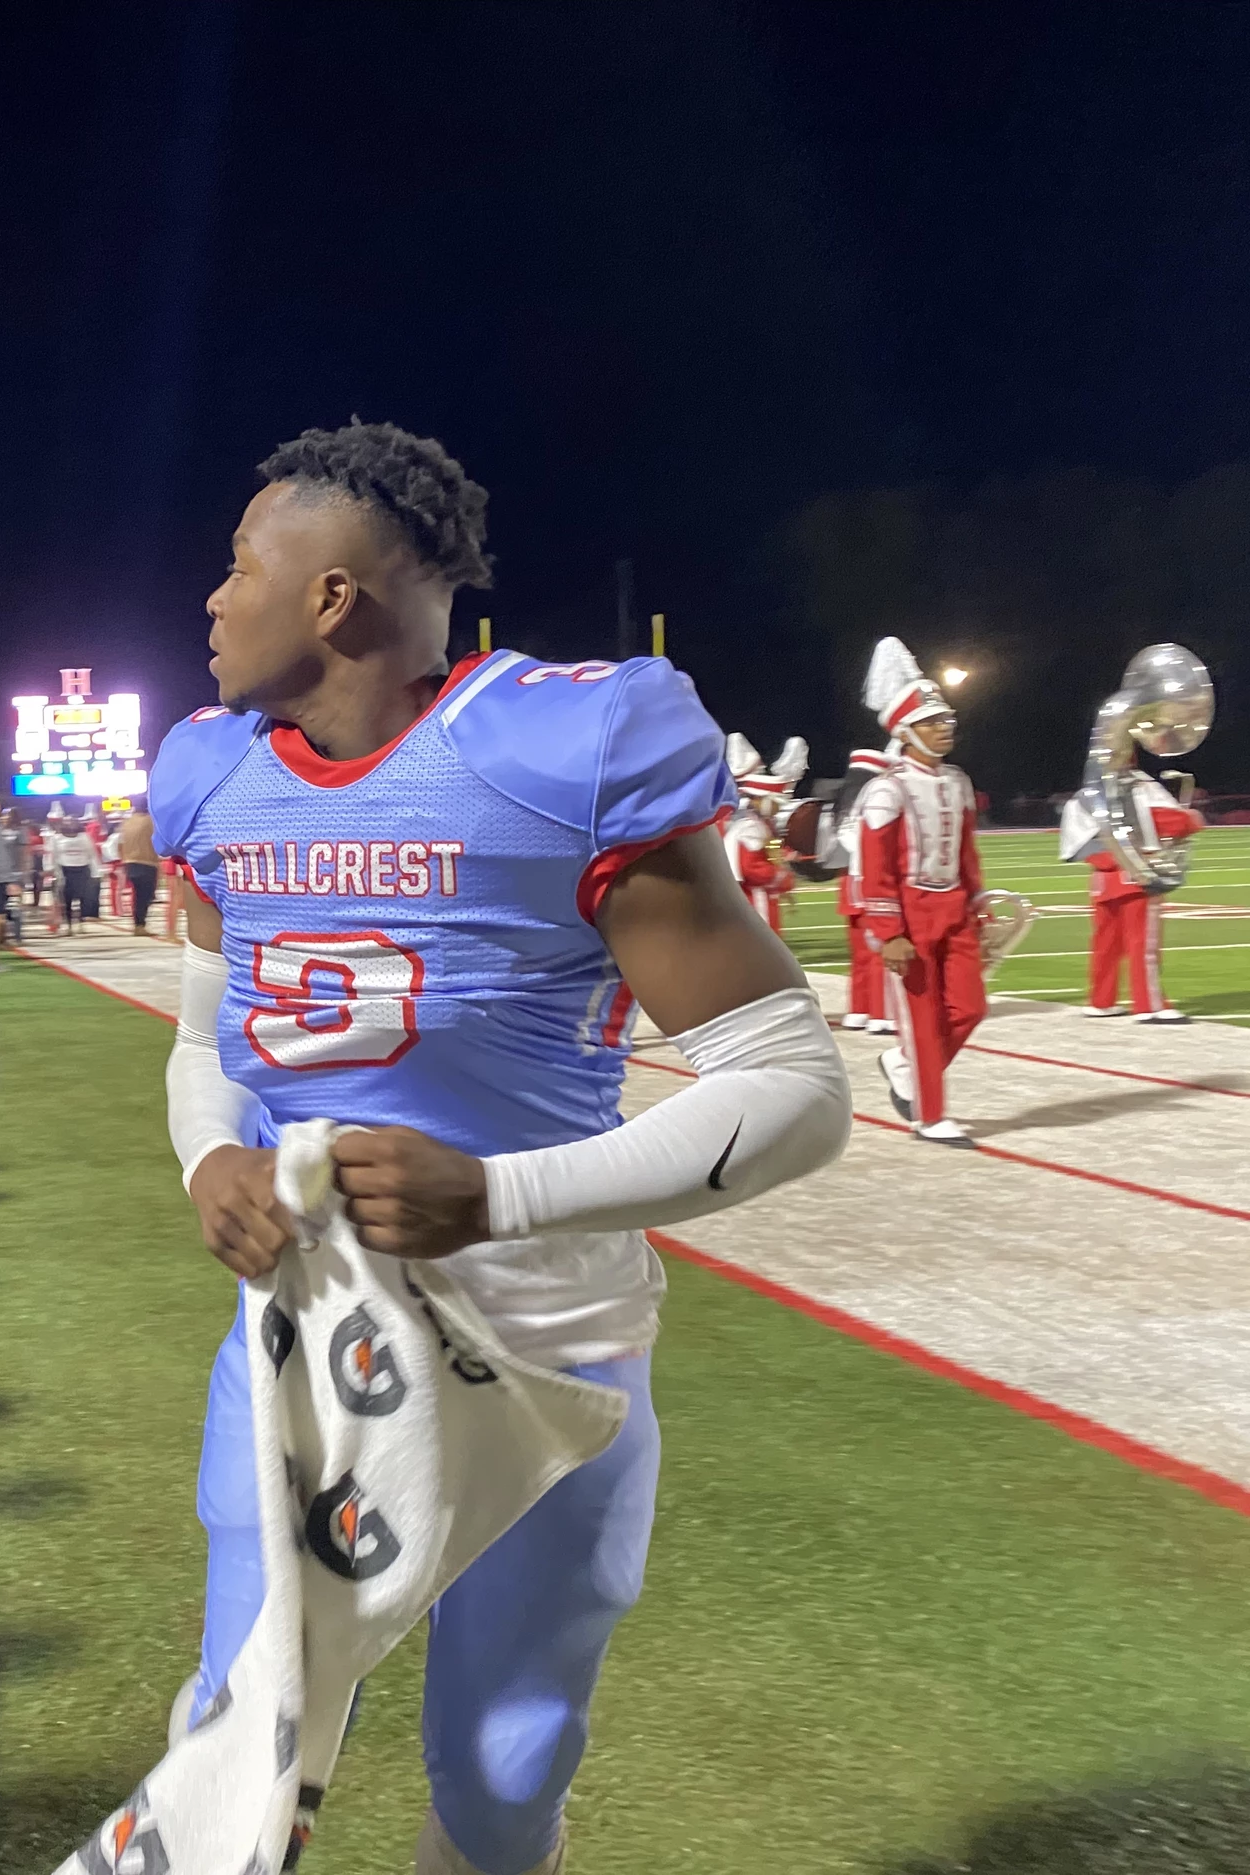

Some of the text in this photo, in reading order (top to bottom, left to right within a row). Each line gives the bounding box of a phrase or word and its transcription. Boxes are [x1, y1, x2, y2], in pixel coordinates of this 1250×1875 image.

[59, 668, 93, 696] H
[216, 841, 464, 898] HILLCREST
[243, 930, 425, 1073] 3
